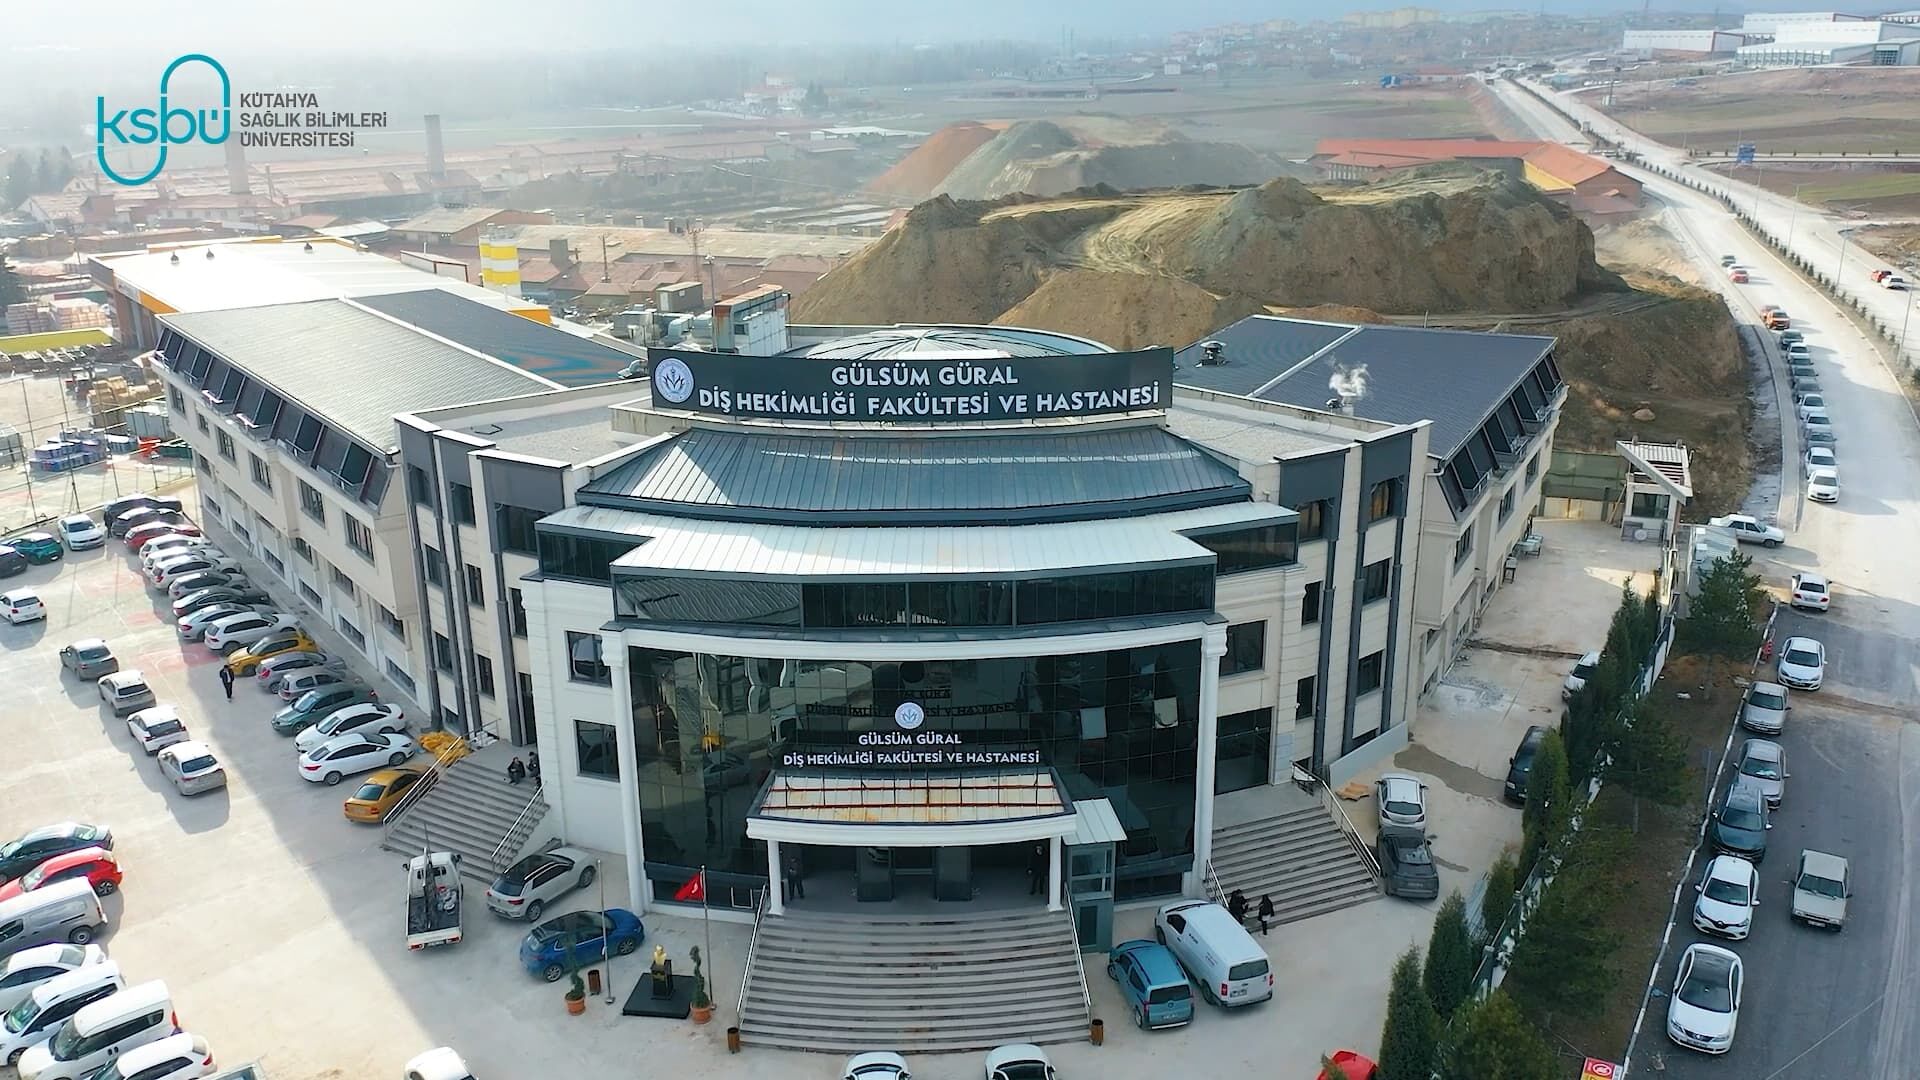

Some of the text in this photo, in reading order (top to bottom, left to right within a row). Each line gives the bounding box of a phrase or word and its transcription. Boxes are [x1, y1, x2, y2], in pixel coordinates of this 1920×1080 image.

[831, 362, 1018, 386] GÜLSÜM GÜRAL
[699, 380, 1159, 416] DİŞ HEKİMLİĞİ FAKÜLTESİ VE HASTANESİ
[858, 731, 962, 746] GÜLSÜM GÜRAL
[783, 750, 1040, 768] DİŞ HEKİMLİĞİ FAKÜLTESİ VE HASTANESİ
